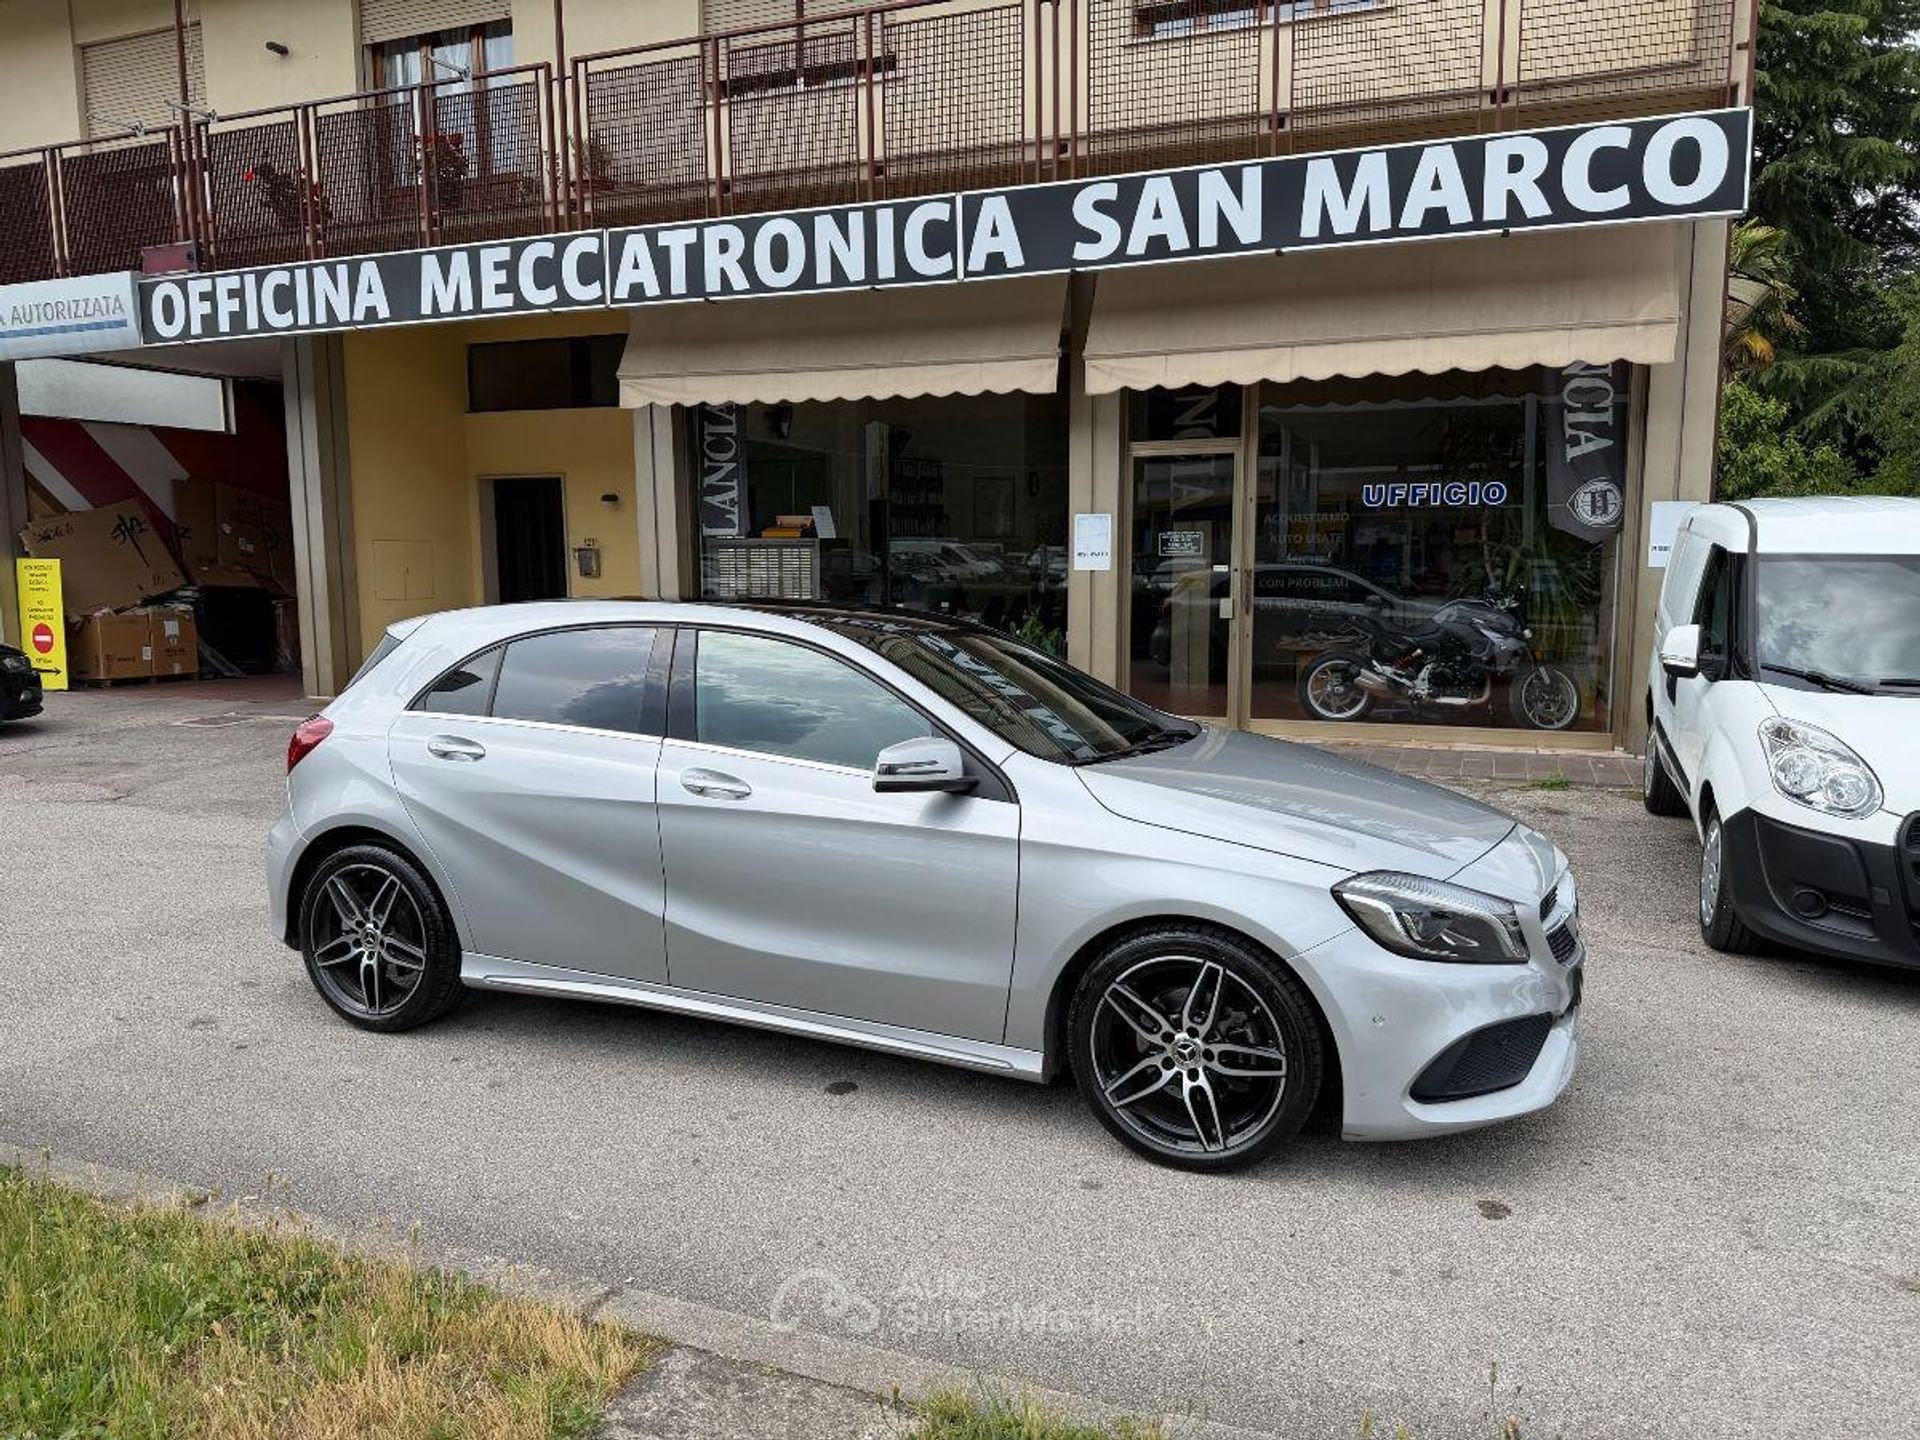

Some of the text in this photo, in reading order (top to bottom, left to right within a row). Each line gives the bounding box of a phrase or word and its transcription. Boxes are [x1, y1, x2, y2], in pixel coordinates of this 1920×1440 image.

[151, 117, 1729, 340] OFFICINA MECCATRONICA SAN MARCO
[11, 294, 125, 327] AUTORIZZATA
[1363, 480, 1508, 508] UFFICIO
[1264, 511, 1350, 524] ACQUISTIAMO
